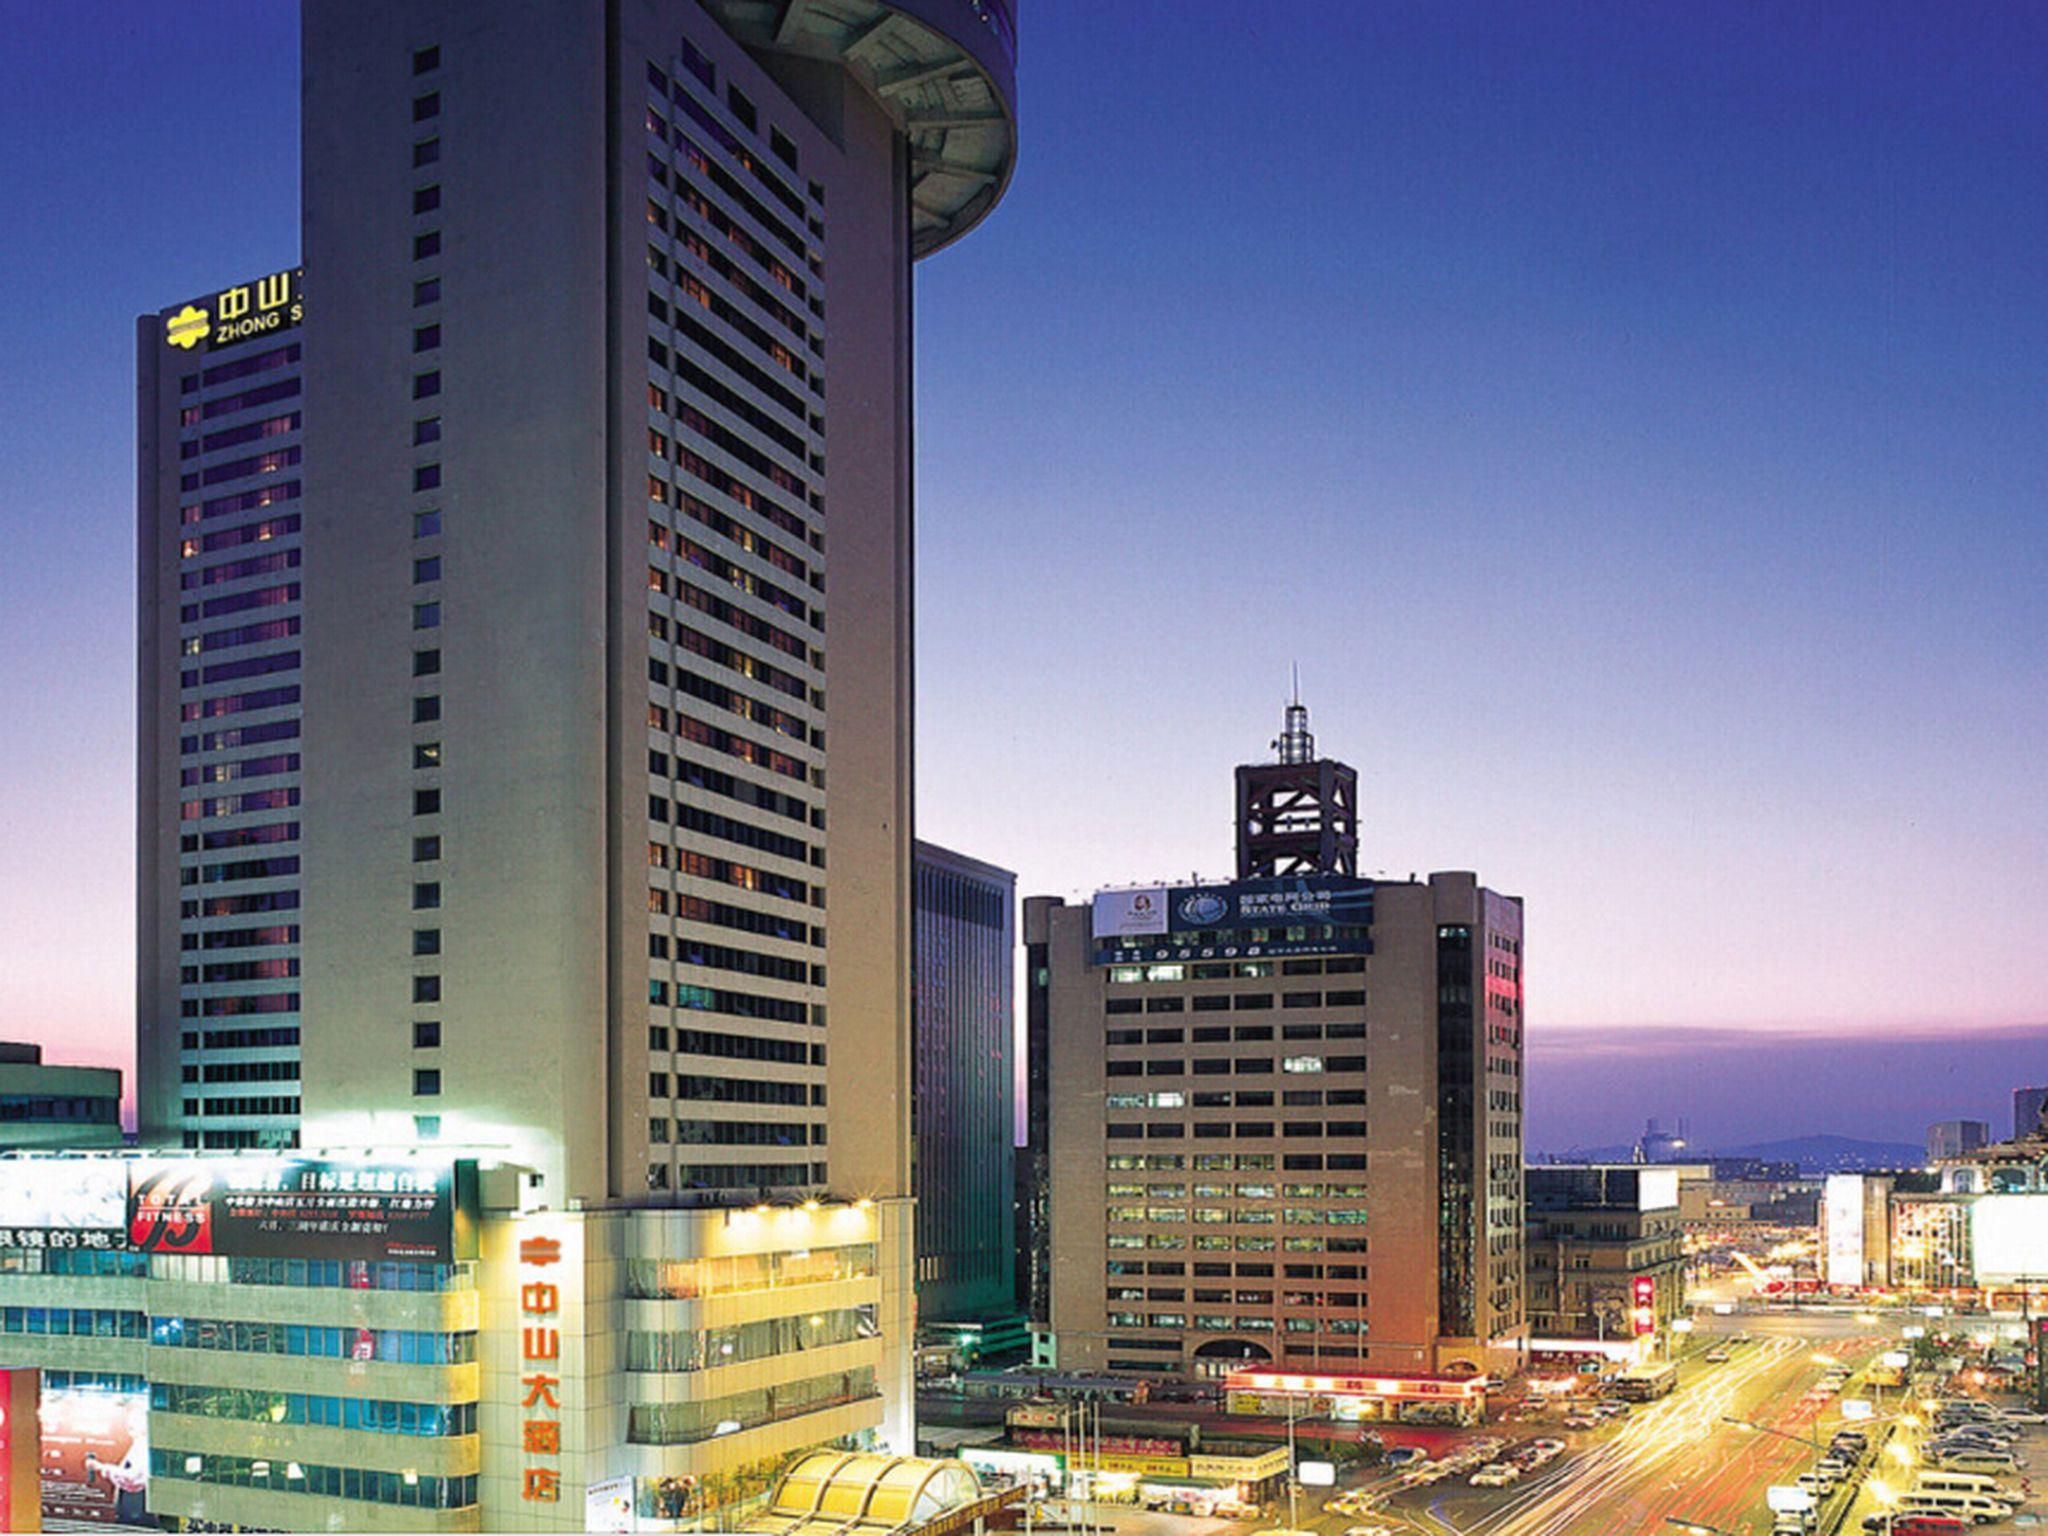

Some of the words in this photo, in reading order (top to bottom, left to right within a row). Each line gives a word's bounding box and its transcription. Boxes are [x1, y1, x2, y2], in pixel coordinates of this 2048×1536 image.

[217, 271, 303, 321] 中山
[216, 311, 280, 343] ZHONG
[1240, 904, 1287, 914] STATE
[137, 1193, 206, 1205] TOTAL
[137, 1210, 206, 1224] FITNESS
[521, 1281, 561, 1504] 中山大酒店
